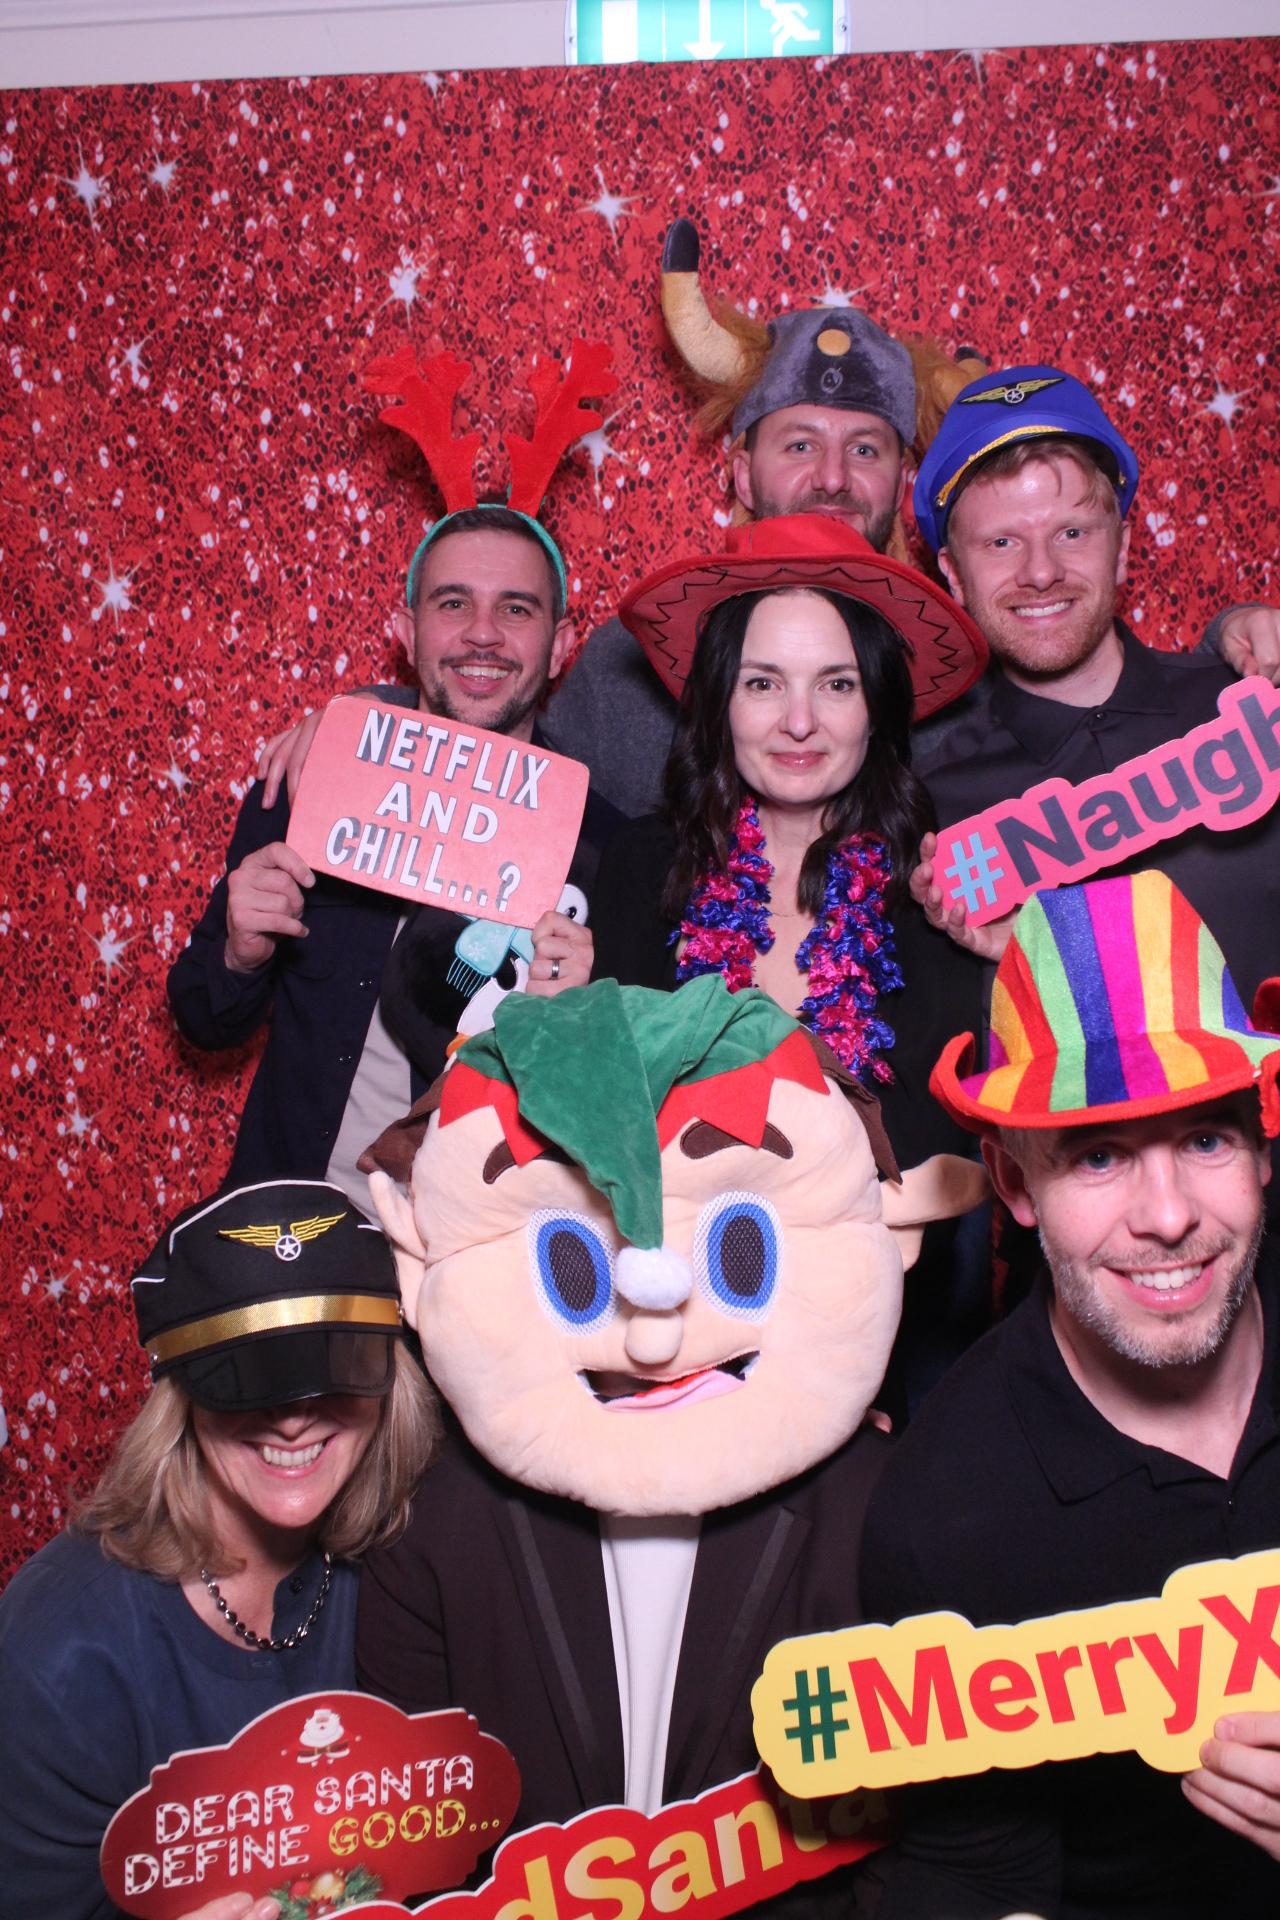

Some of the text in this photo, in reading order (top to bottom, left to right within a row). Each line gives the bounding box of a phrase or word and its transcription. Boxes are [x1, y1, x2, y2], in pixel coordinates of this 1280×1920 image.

[356, 708, 550, 809] NETFLIX
[375, 781, 499, 843] AND
[326, 817, 522, 912] CHILL...?
[782, 1585, 1280, 1764] #MerryX
[125, 1799, 501, 1896] DEFINE GOOD...
[156, 1755, 474, 1844] DEAR SANTA
